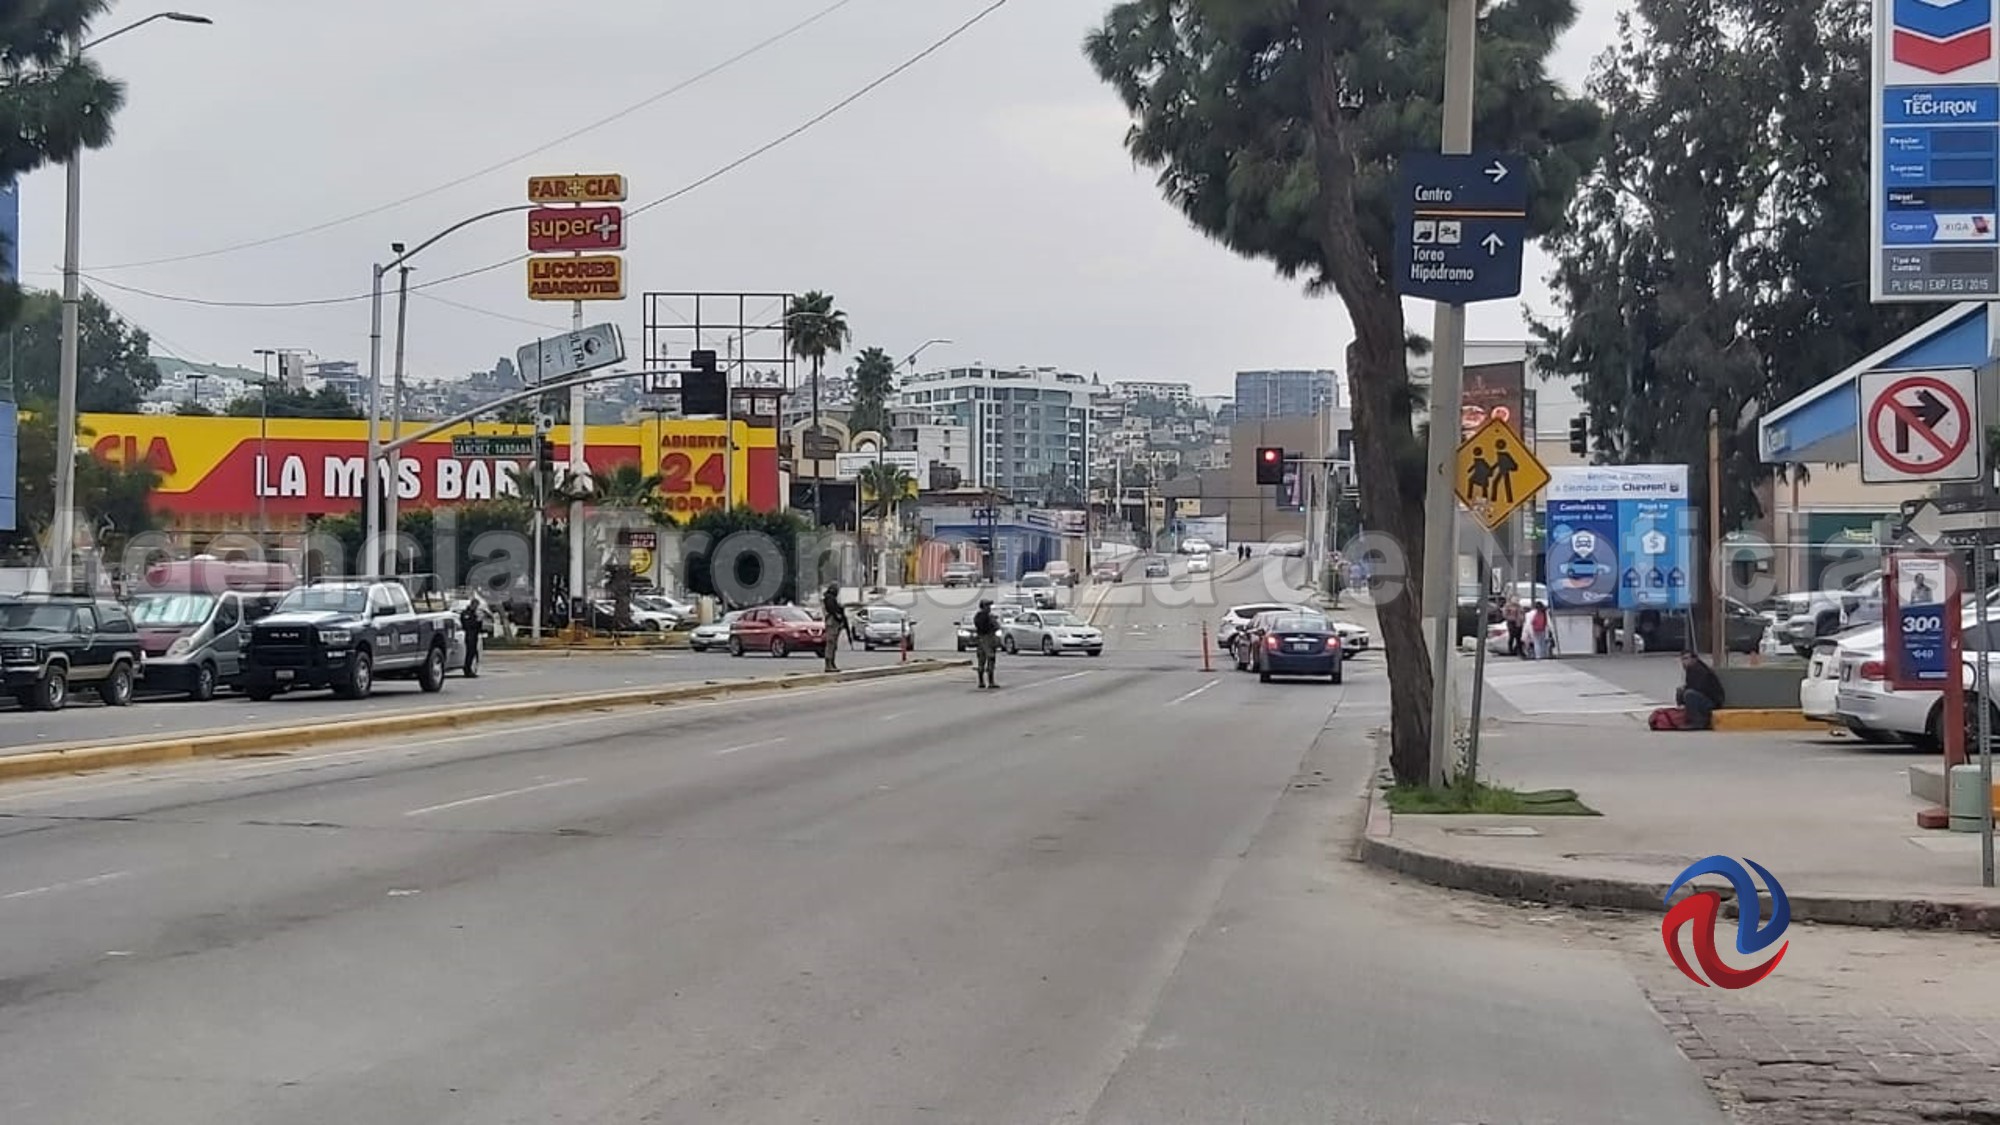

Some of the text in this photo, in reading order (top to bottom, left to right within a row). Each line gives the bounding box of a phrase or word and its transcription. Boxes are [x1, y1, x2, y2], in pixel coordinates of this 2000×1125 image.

[1903, 99, 1977, 117] TECHRON
[1415, 185, 1453, 202] Centro
[1412, 245, 1445, 262] Toreo
[533, 261, 616, 279] LICORES
[1410, 263, 1475, 284] Hipódromo
[531, 280, 619, 294] ABARROTES
[256, 455, 307, 496] LA
[437, 458, 594, 501] BART
[661, 453, 725, 493] 24
[1622, 483, 1666, 492] Chevron!
[1902, 616, 1941, 632] 300
